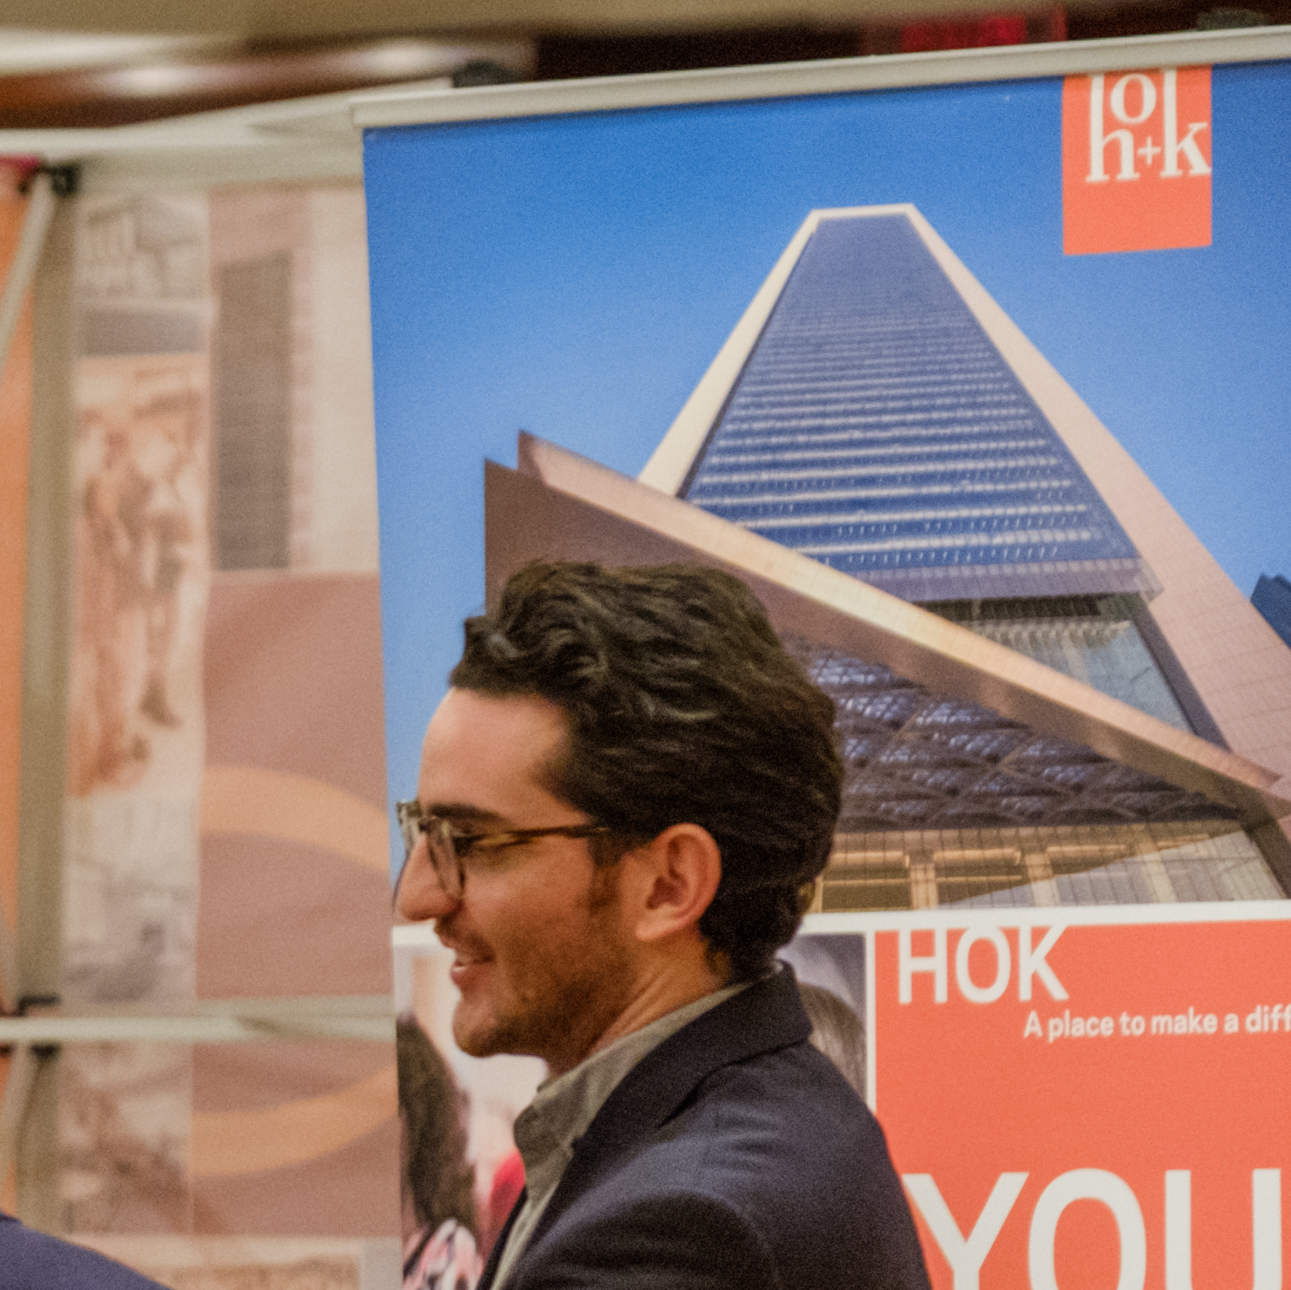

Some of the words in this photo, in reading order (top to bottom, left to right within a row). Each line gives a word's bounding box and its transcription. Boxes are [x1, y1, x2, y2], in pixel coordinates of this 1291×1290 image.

[898, 924, 1070, 1005] HOK
[1023, 1010, 1043, 1038] A
[1048, 1009, 1114, 1043] place
[1120, 1011, 1146, 1036] to
[1151, 1006, 1218, 1034] make
[1224, 1013, 1240, 1034] a
